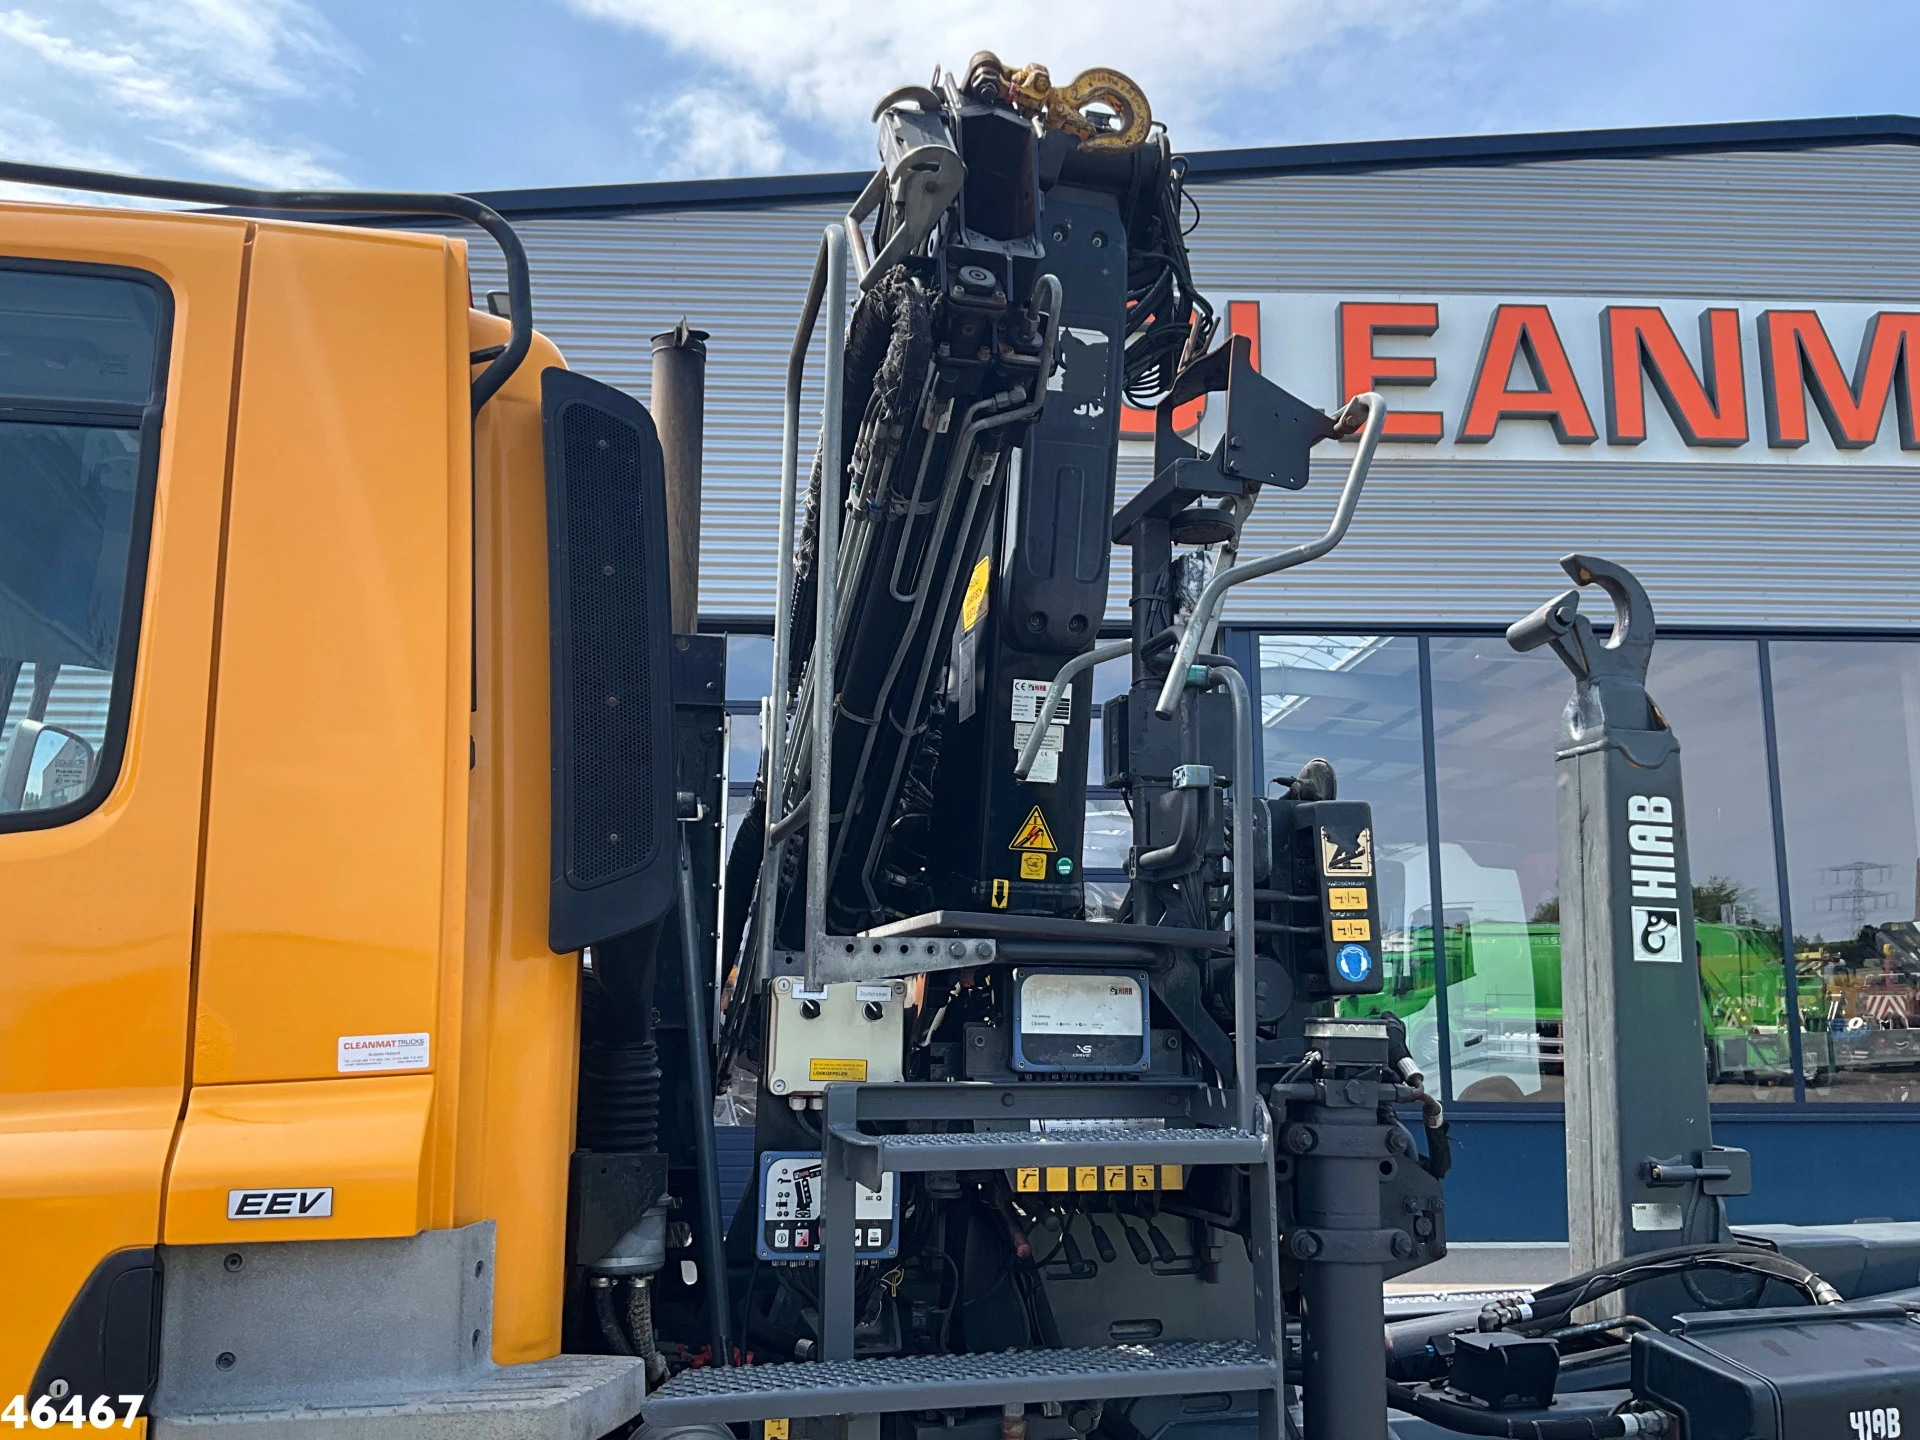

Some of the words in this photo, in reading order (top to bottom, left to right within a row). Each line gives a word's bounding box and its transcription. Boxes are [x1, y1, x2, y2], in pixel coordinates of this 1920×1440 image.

[1627, 795, 1677, 899] HIAB
[343, 1040, 397, 1049] CLEANMAT
[234, 1192, 326, 1215] EEV
